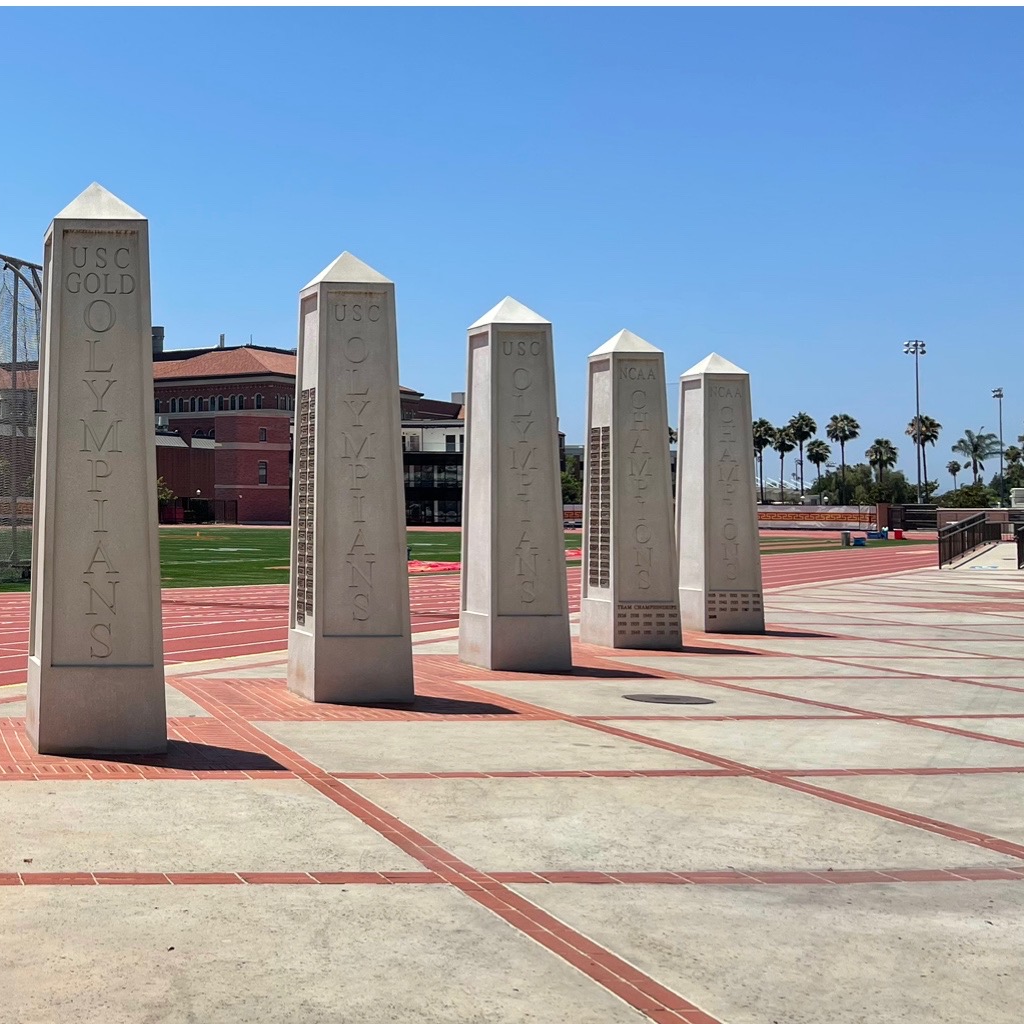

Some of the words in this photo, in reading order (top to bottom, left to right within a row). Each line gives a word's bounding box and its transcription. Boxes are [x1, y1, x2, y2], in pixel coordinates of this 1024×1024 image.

[70, 246, 131, 270] USC
[65, 272, 136, 295] GOLD
[334, 304, 381, 322] USC
[502, 341, 541, 357] USC
[619, 367, 656, 381] NCAA
[710, 386, 742, 398] NCAA
[79, 299, 123, 658] OLYMPIANS
[341, 336, 377, 621] OLYMPIANS
[509, 367, 538, 604] OLYMPIANS
[627, 389, 653, 590] CHAMPIONS
